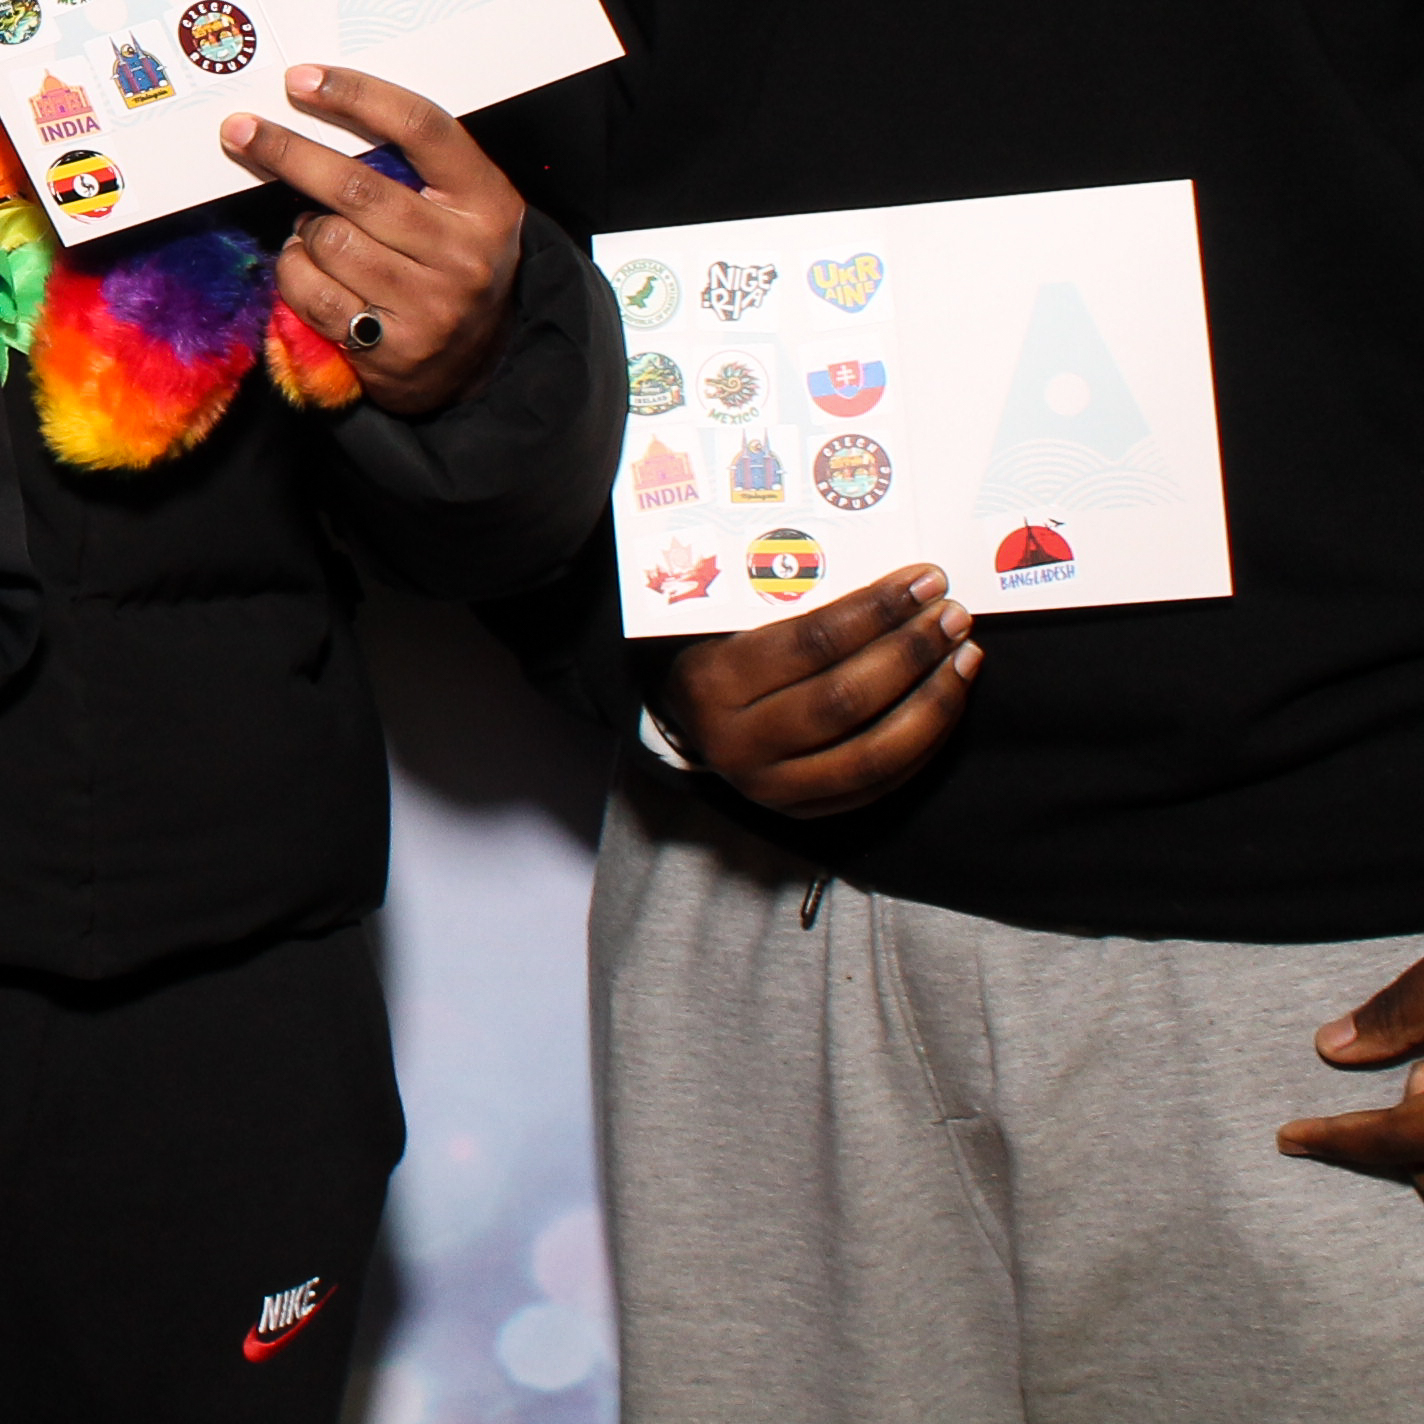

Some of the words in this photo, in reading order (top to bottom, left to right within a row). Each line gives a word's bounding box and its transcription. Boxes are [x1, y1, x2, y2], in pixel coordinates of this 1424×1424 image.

[40, 116, 101, 142] INDIA
[708, 407, 760, 424] MEXICO
[639, 484, 700, 510] INDIA
[1000, 565, 1075, 590] BANGLADESH
[258, 1276, 320, 1333] NIKE
